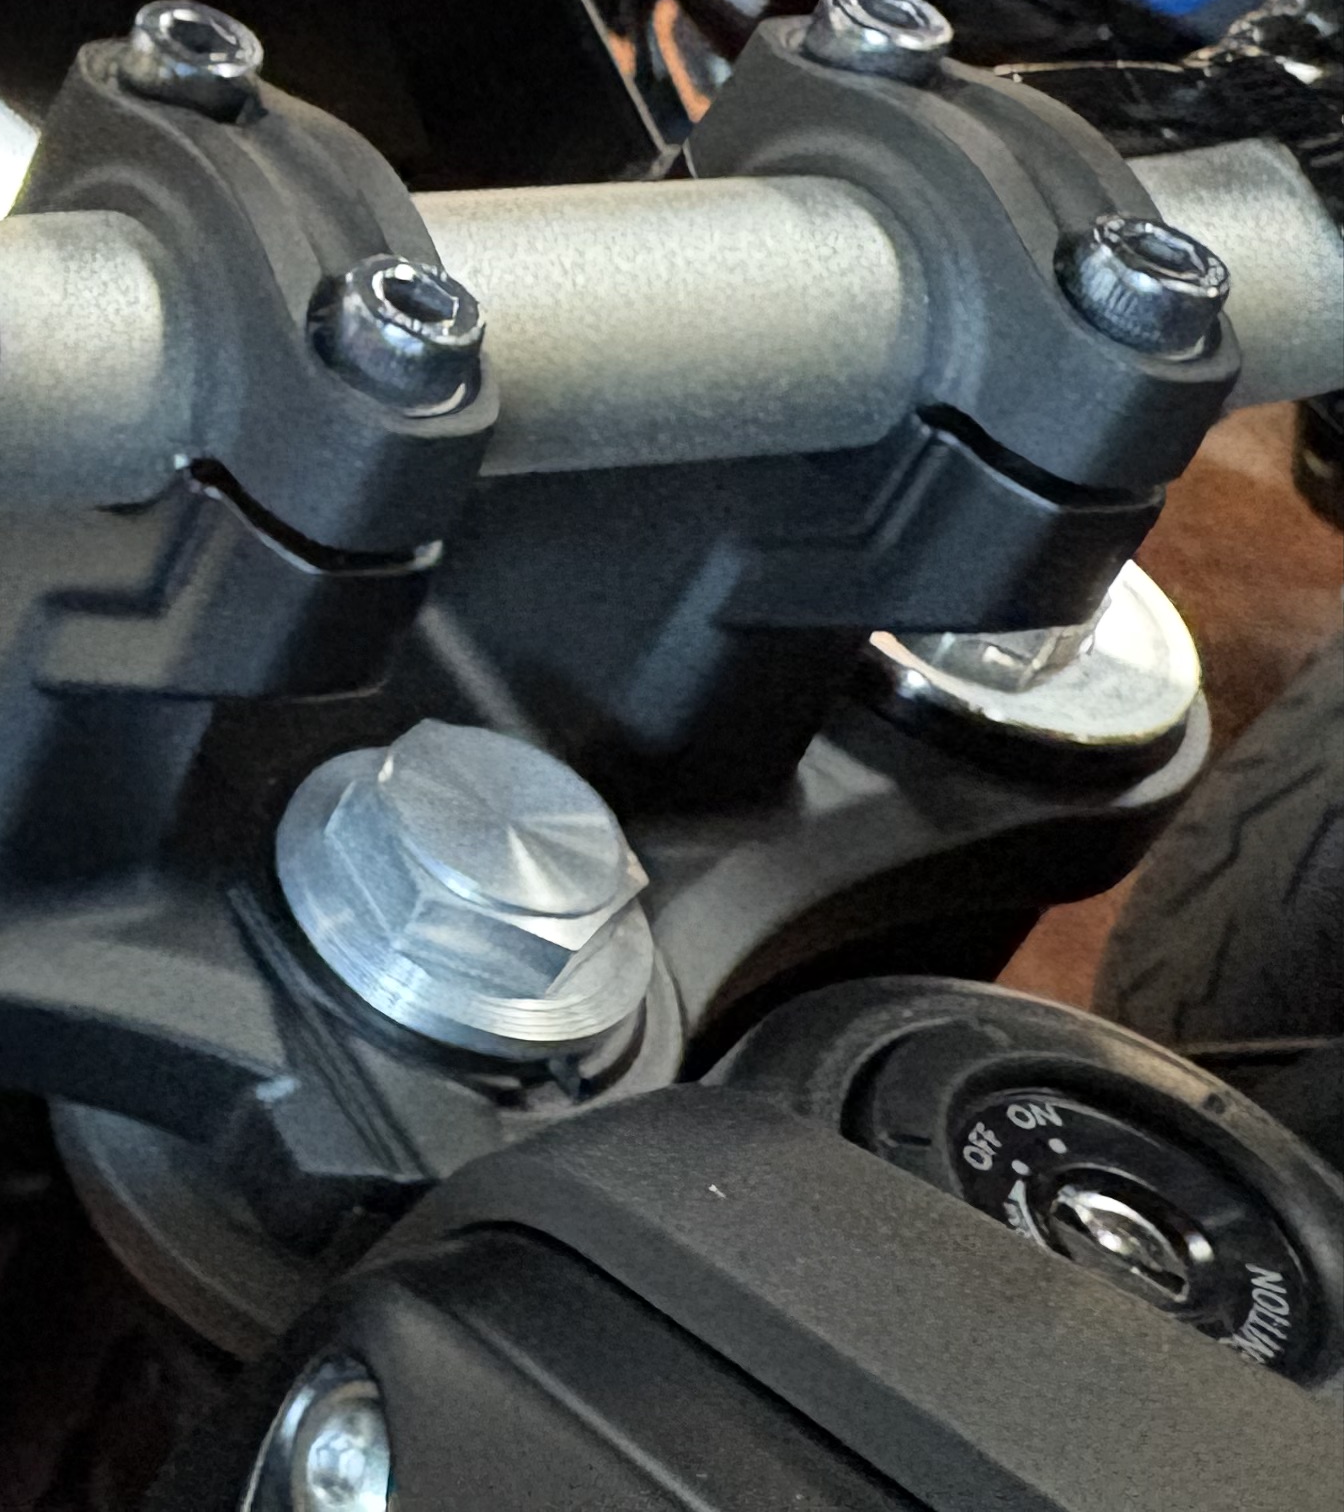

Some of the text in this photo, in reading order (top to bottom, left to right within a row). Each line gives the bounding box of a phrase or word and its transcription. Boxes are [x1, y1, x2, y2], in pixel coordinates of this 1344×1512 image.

[1006, 1102, 1064, 1130] ON
[962, 1121, 1003, 1171] OFF
[1219, 1262, 1291, 1365] NITION
